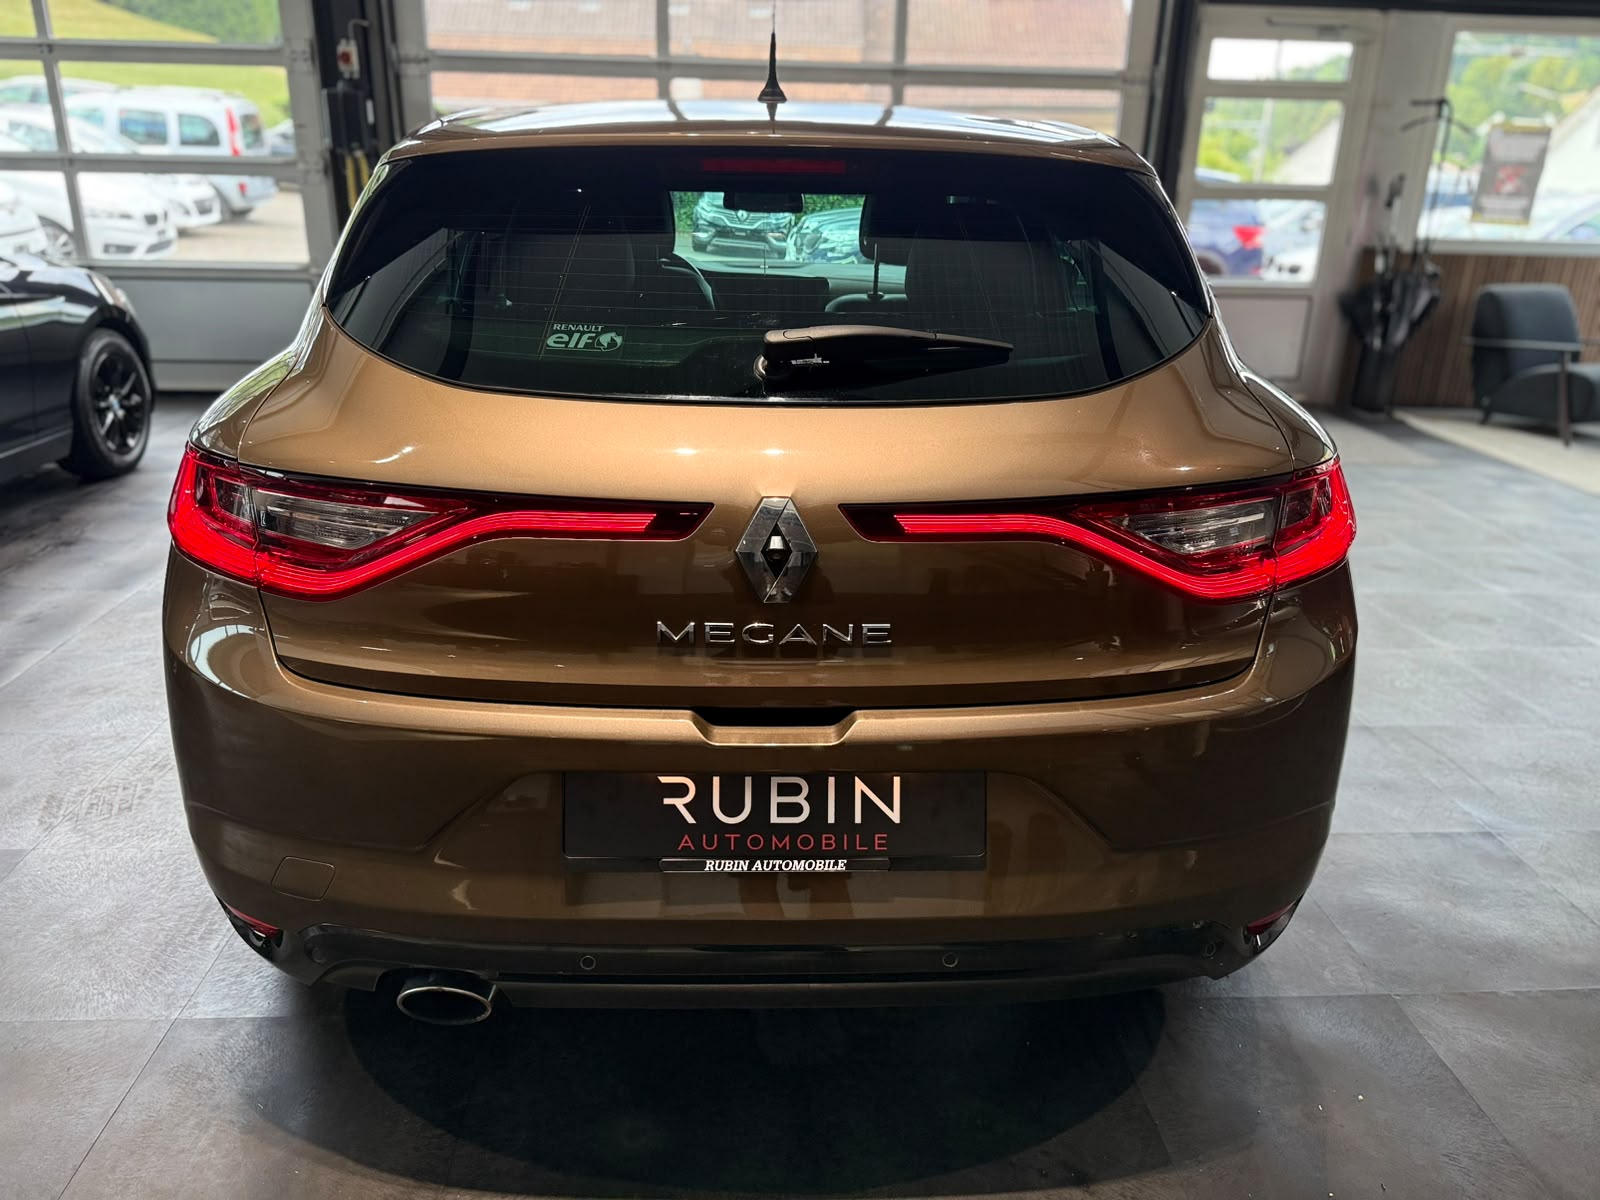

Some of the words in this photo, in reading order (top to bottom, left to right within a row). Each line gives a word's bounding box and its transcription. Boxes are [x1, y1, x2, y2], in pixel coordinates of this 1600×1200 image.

[553, 323, 604, 332] RENAULT
[546, 333, 596, 348] elf
[656, 621, 892, 645] MEGANE
[657, 776, 901, 824] RUBIN
[678, 834, 888, 850] AUTOMOBILE
[704, 860, 749, 871] RUBIN
[752, 859, 847, 871] AUTOMOBILE
